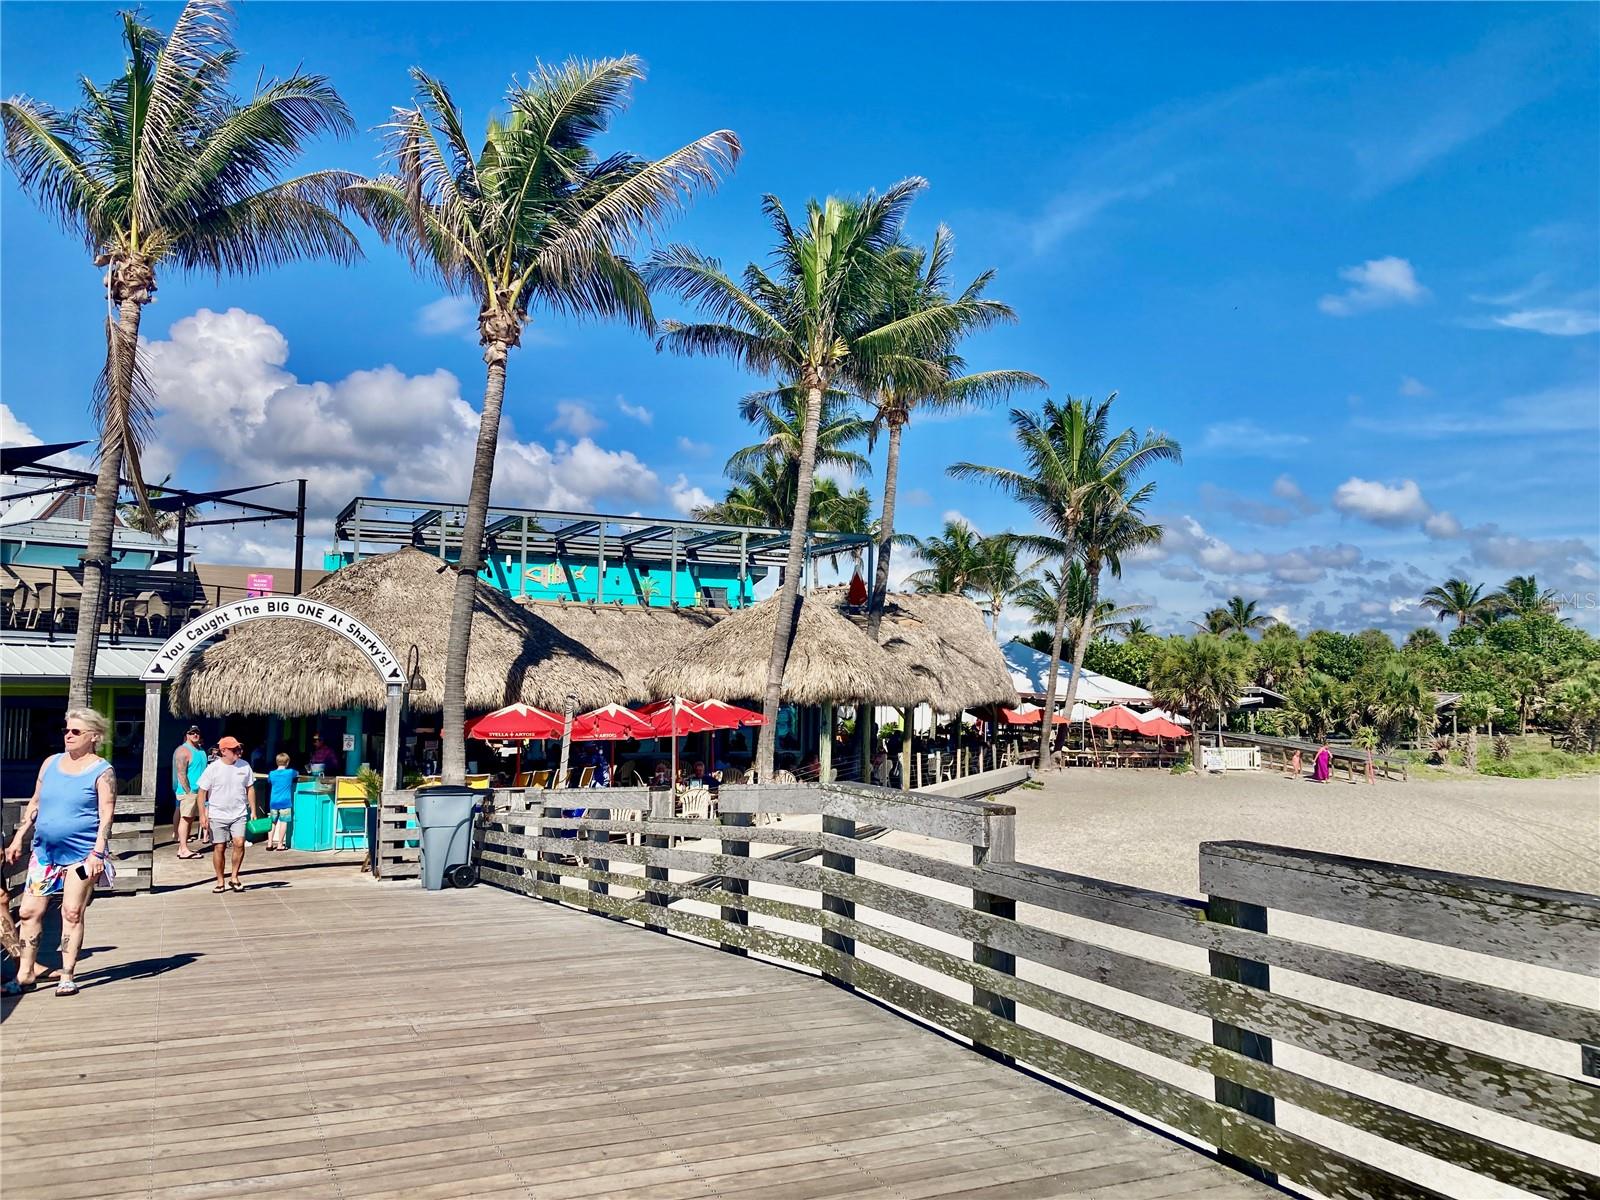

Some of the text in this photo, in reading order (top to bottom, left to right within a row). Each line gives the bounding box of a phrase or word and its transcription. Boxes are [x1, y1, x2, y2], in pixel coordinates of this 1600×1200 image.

[162, 601, 392, 667] You Caught The BIG ONE At Sharky's!
